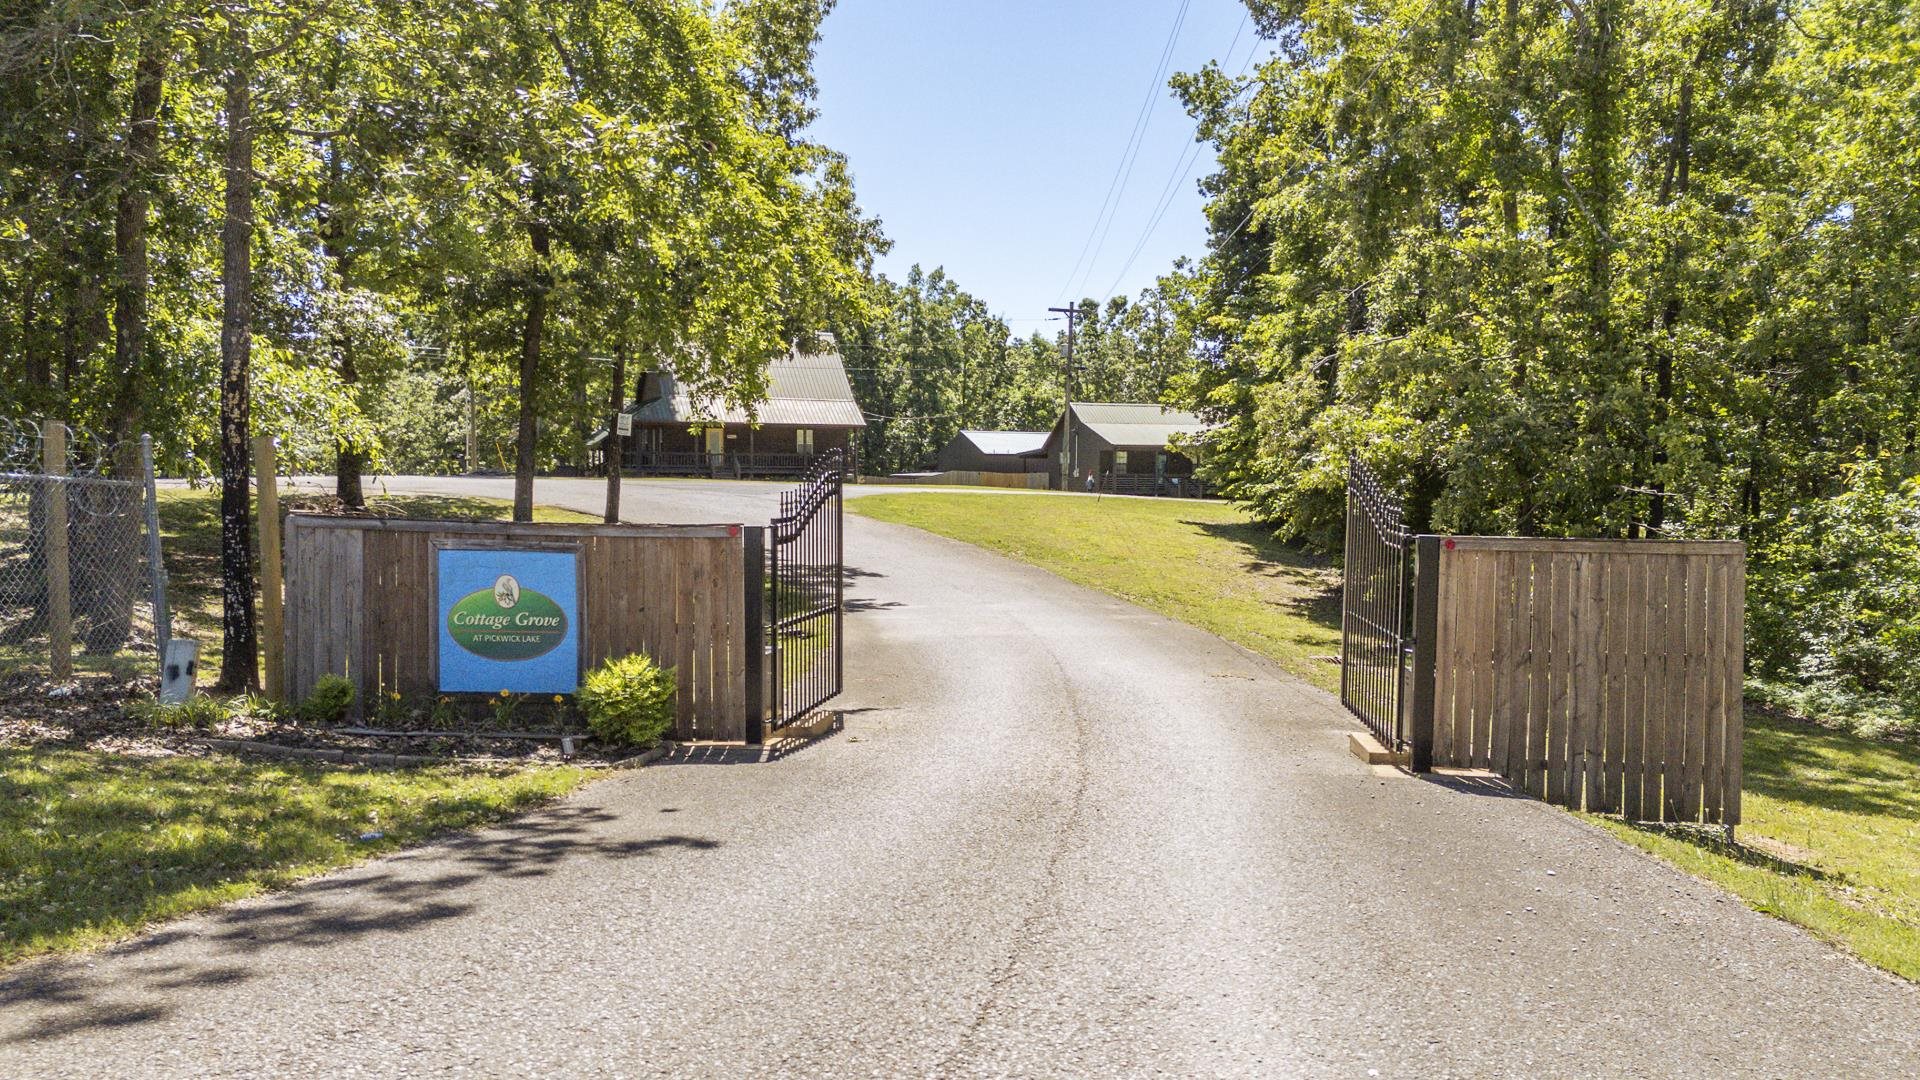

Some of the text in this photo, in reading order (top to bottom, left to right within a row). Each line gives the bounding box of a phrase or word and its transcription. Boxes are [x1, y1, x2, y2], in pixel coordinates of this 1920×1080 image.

[454, 611, 560, 629] Cottage Grove
[472, 634, 541, 643] AT PICKWICK LAKE
